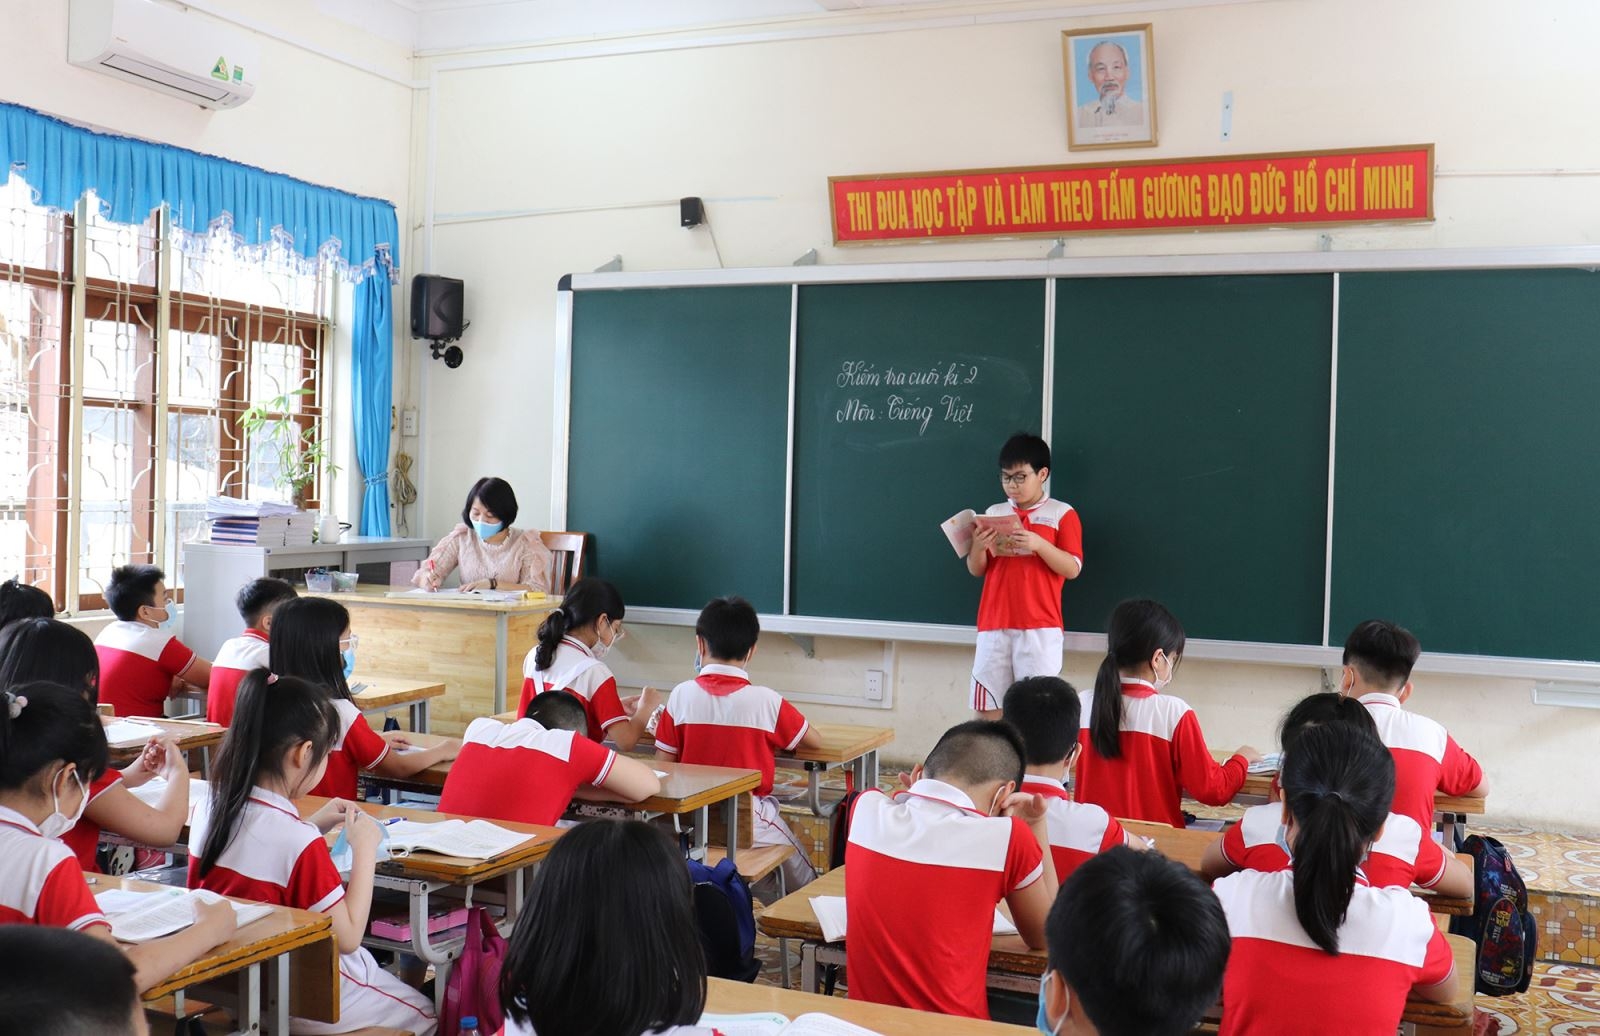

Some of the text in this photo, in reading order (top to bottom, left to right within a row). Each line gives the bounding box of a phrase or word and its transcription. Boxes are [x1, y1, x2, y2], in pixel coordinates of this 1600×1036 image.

[847, 158, 1414, 235] THI ĐUA HỌC TẬP VÀ LÀM THEO TẤM GƯƠNG ĐẠO ĐỨC HỒ CHÍ MINH
[884, 366, 906, 386] tra
[963, 366, 978, 385] 2
[940, 394, 974, 428] Việt
